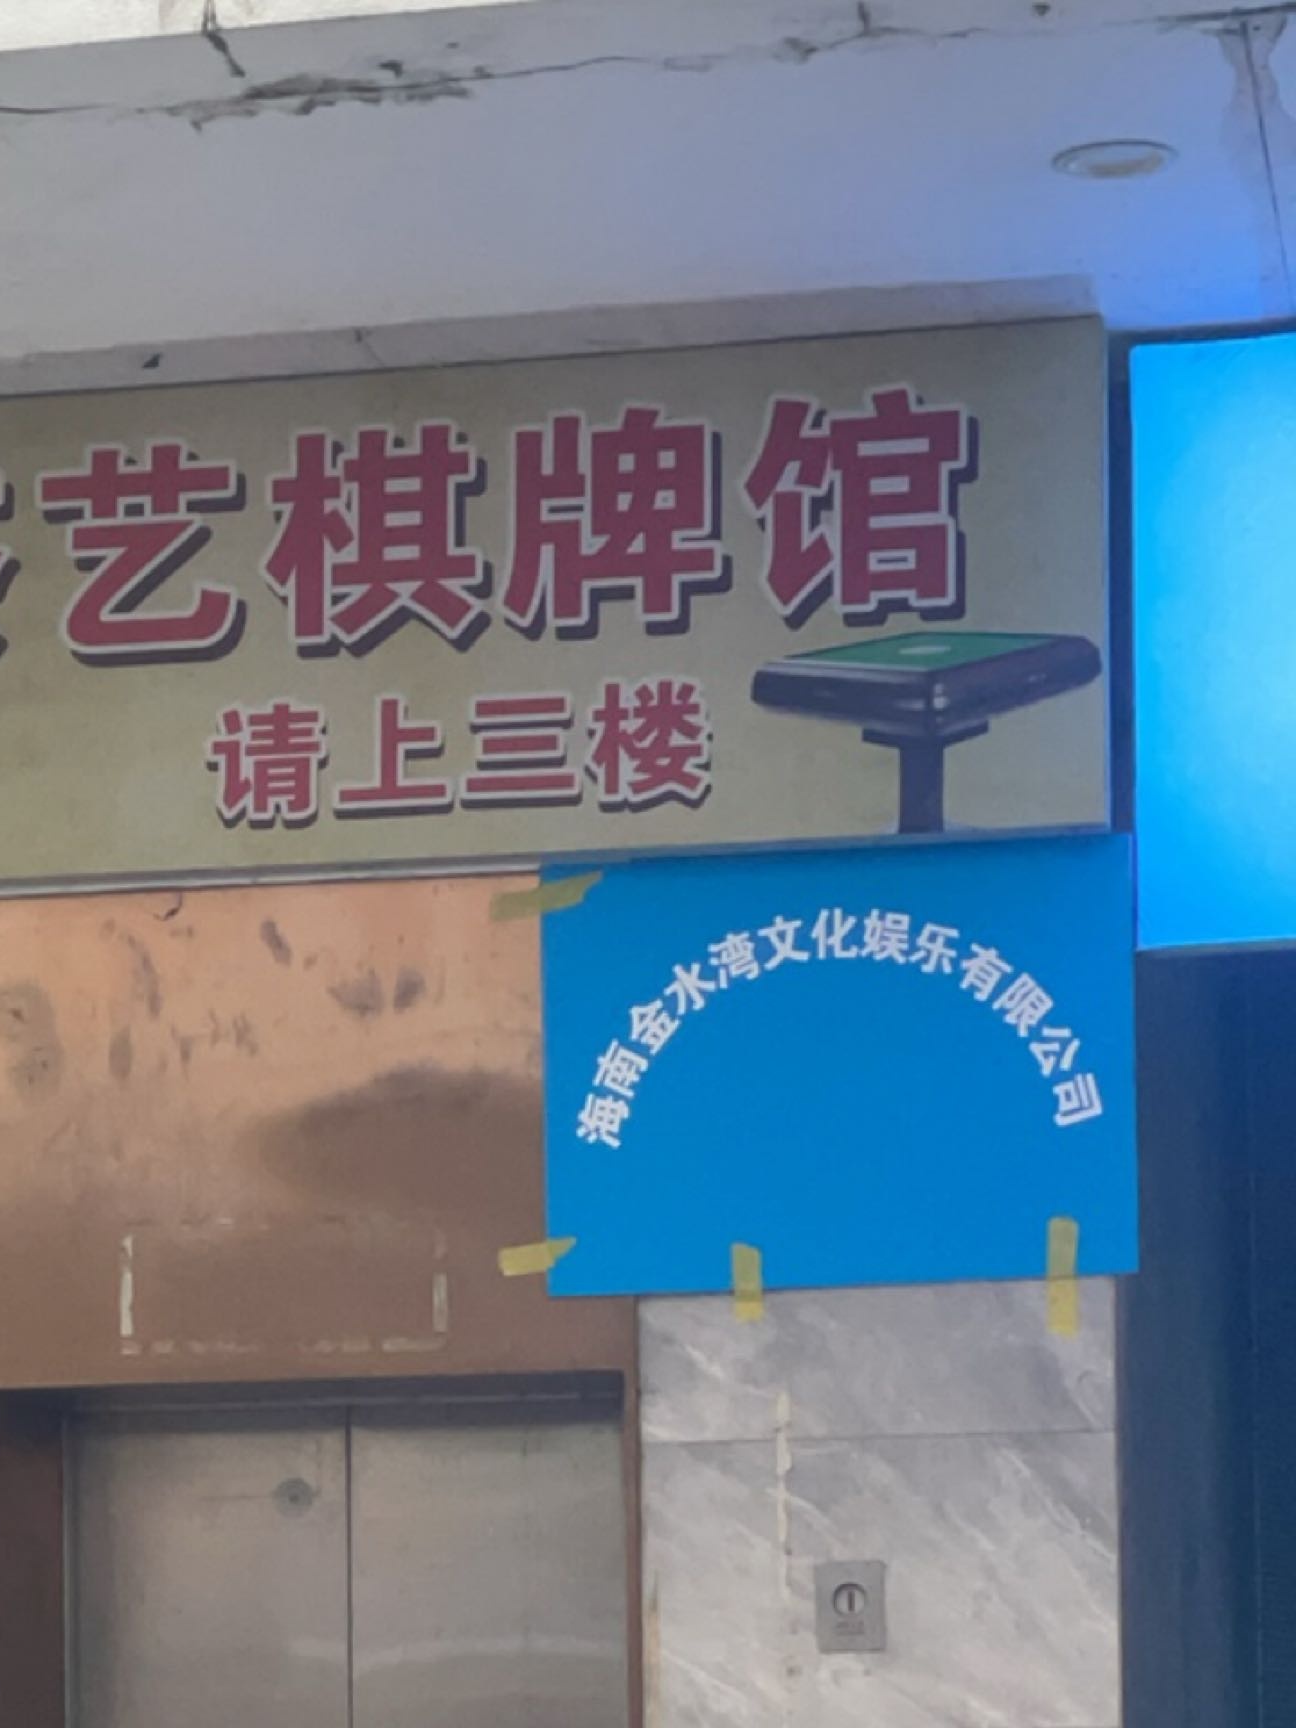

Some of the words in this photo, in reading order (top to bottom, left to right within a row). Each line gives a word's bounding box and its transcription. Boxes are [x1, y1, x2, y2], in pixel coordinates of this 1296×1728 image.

[211, 682, 708, 820] 请上三楼
[576, 908, 1103, 1149] 海南金水湾文化娱乐有限公司
